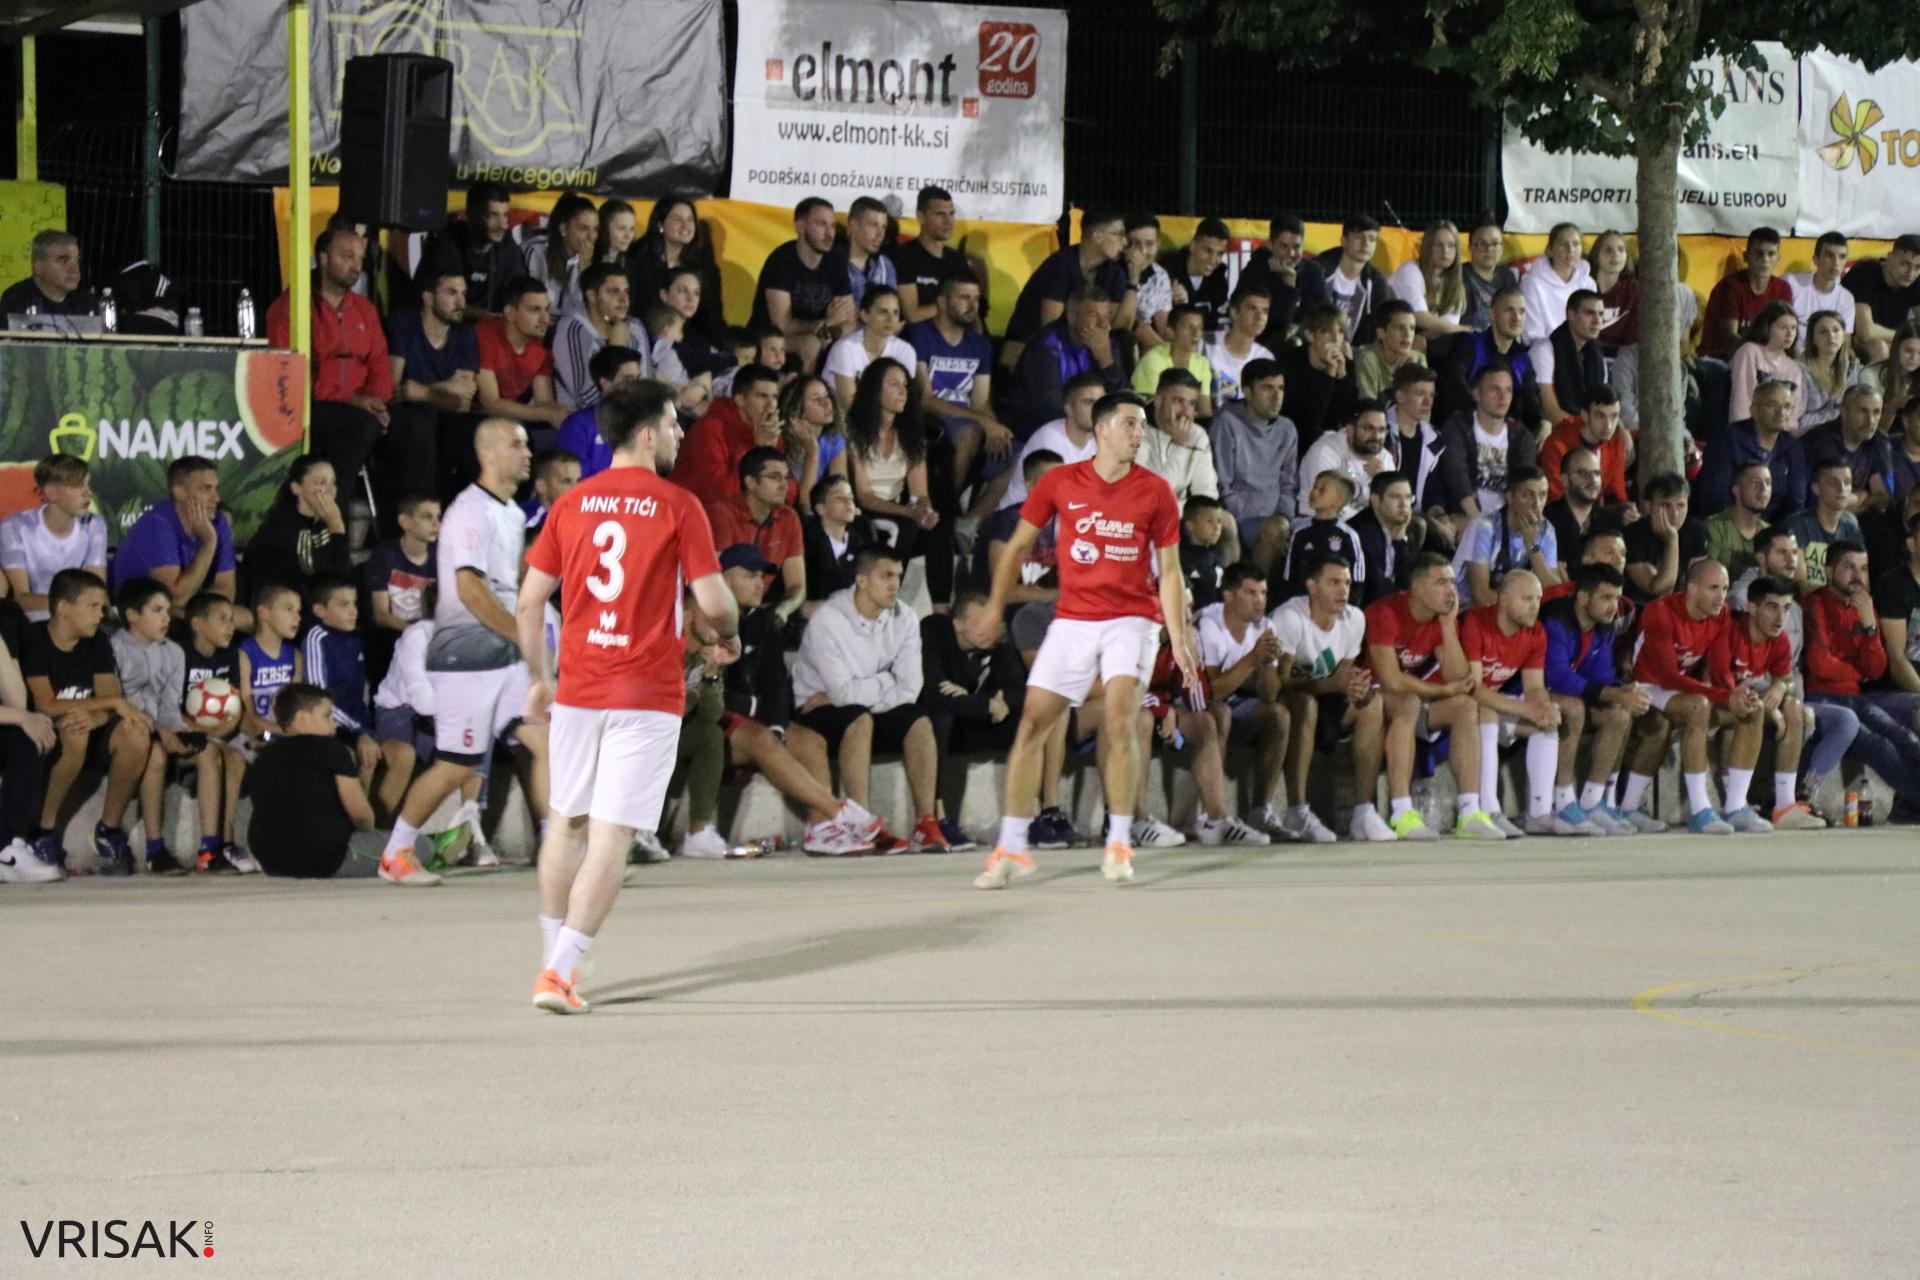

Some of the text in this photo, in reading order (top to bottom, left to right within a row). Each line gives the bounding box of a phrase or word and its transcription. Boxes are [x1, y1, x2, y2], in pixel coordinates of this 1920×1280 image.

[977, 31, 1040, 73] 20
[792, 41, 956, 107] elmont
[987, 78, 1029, 96] godina
[778, 120, 949, 148] www.elmont-kk.si
[476, 162, 598, 189] Hercegovini
[748, 167, 810, 186] PODRŠKA
[990, 180, 1048, 196] SUSTAVA
[1523, 187, 1632, 204] TRANSPORTI
[1723, 191, 1787, 208] EUROPU
[99, 418, 245, 460] NAMEX
[580, 496, 657, 517] MNK TIĆI
[586, 520, 627, 603] 3
